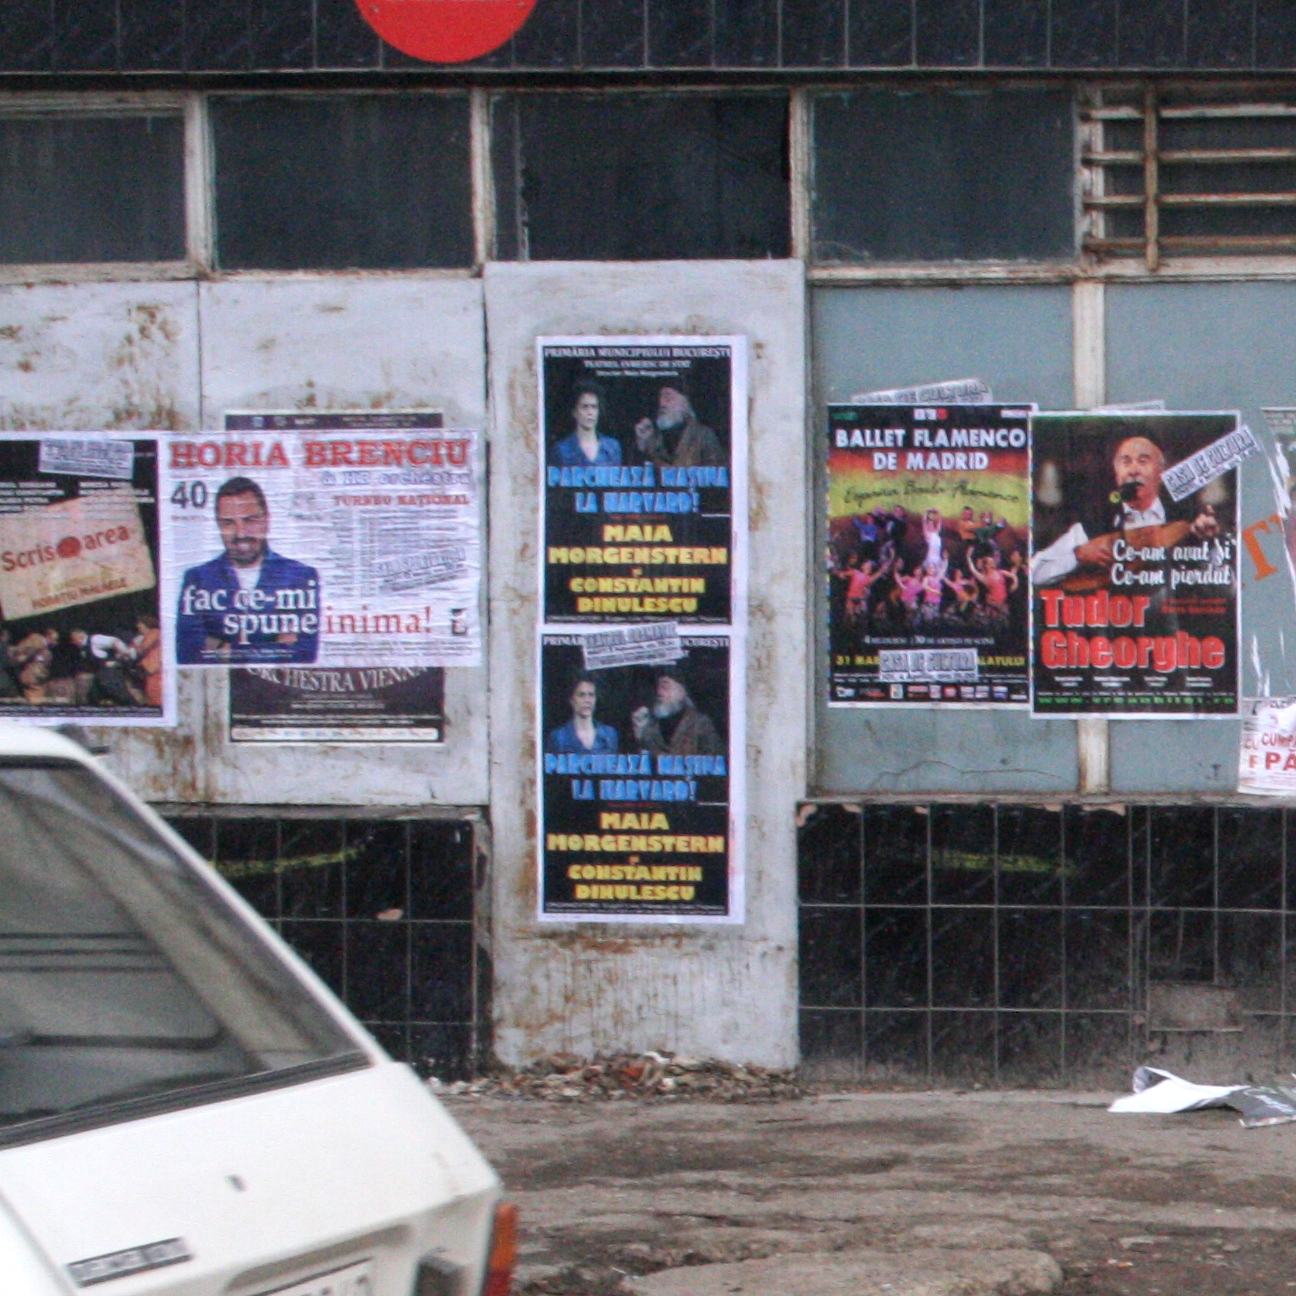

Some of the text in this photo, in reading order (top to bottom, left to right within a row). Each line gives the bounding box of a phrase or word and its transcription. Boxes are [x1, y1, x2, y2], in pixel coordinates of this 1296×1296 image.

[835, 428, 1026, 448] BALLET FLAMENCO
[168, 438, 470, 468] HORIA BRENCIU
[873, 452, 989, 471] DE MADRID
[170, 480, 208, 509] 40
[603, 524, 673, 542] MAIA
[549, 547, 728, 565] MORGENSTERN
[1113, 539, 1166, 561] Ce-am
[1172, 541, 1209, 561] avut
[569, 577, 705, 593] CONSTANTIN
[1111, 563, 1231, 590] Ce-am pierdut
[182, 579, 318, 616] fac ce-mi
[577, 597, 698, 613] DINULESCU
[1040, 589, 1150, 629] Tudor
[223, 606, 432, 646] spune inima!
[1040, 630, 1226, 674] Gheorghe
[600, 812, 670, 830] MAIA
[546, 834, 726, 854] MORGENSTERN
[567, 864, 703, 882] CONSTANTIN
[575, 884, 696, 901] DINULESCU
